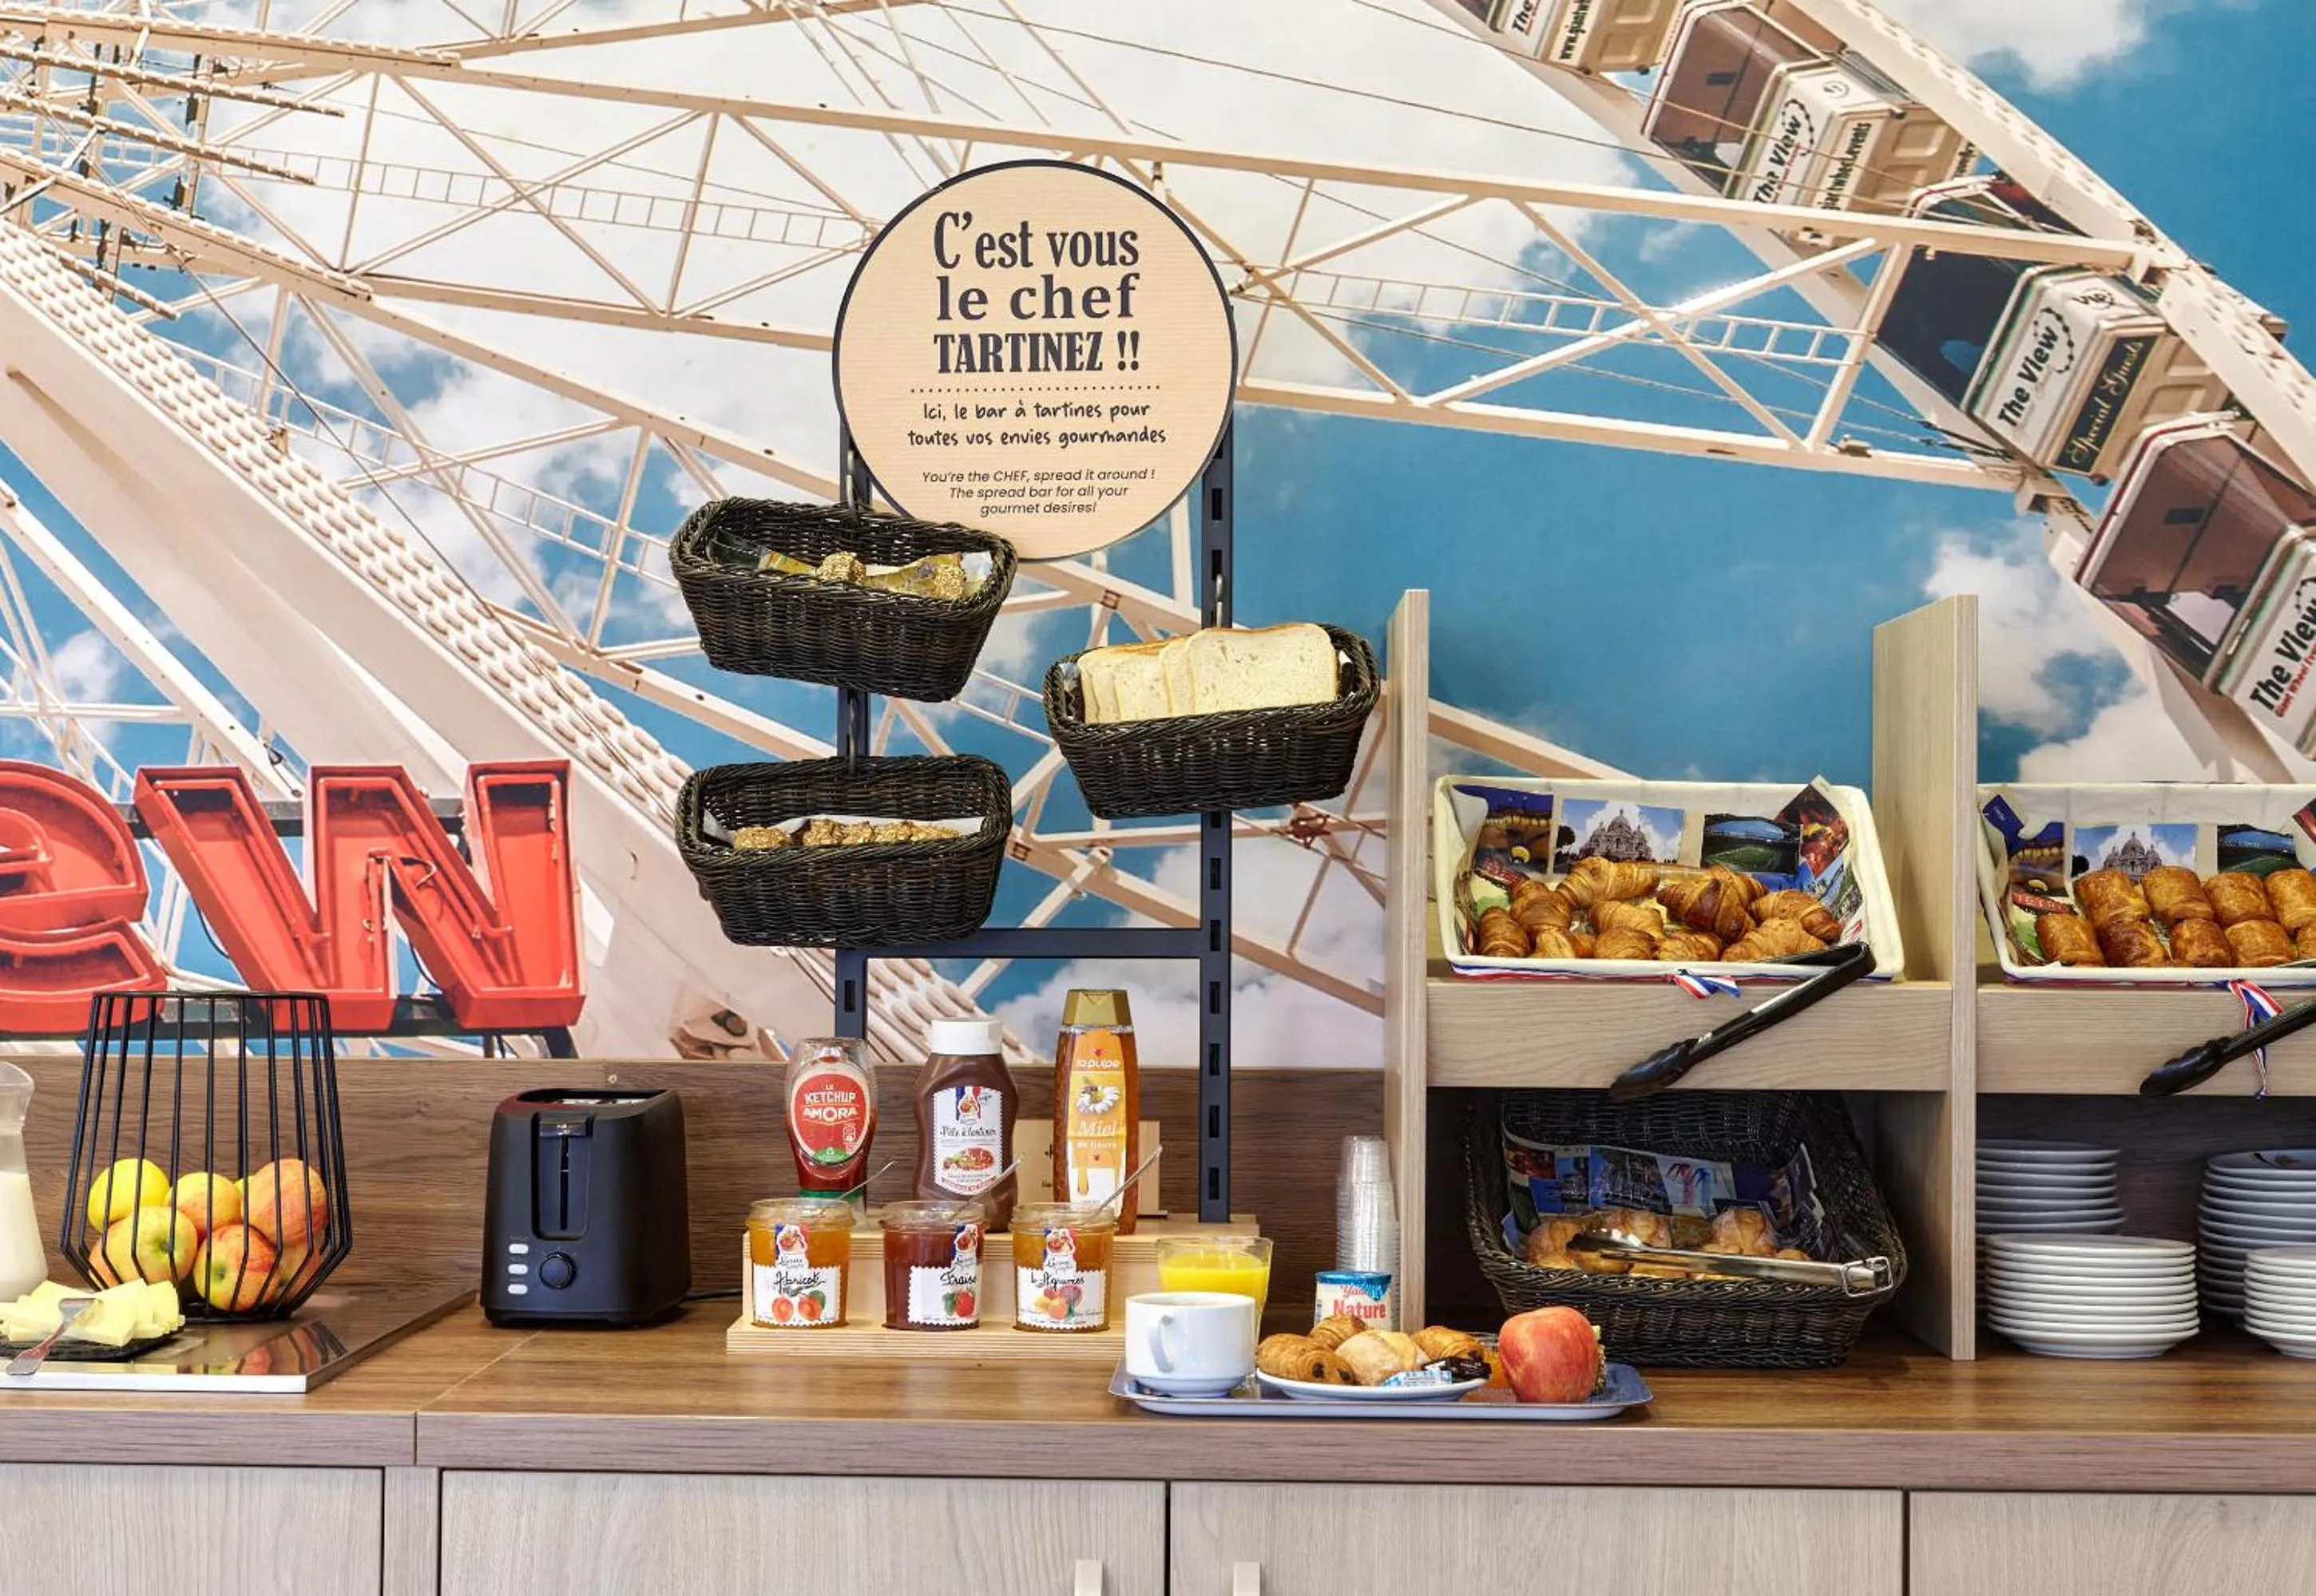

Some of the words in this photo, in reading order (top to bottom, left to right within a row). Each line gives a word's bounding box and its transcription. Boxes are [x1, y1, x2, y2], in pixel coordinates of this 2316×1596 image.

[934, 211, 1033, 269] C'est
[1046, 230, 1139, 267] vous
[936, 275, 989, 320] le
[1009, 272, 1140, 319] chef
[934, 331, 1104, 374] TARTINEZ
[1116, 330, 1140, 371] !!
[1997, 386, 2031, 427] The
[2017, 326, 2059, 385] View
[923, 402, 946, 422] Ici,
[954, 402, 968, 420] le
[975, 403, 1008, 420] bar
[1014, 398, 1026, 418] à
[1033, 402, 1102, 419] tartines
[1108, 403, 1152, 422] pour
[906, 429, 959, 446] toutes
[966, 431, 993, 446] vos
[1000, 428, 1052, 446] envies
[1058, 425, 1168, 449] gourmandes
[2066, 396, 2112, 464] Special
[922, 470, 965, 483] You're
[967, 470, 991, 483] the
[993, 469, 1030, 484] CHEF,
[1033, 469, 1083, 485] spread
[1085, 469, 1095, 481] it
[1097, 468, 1148, 481] around
[950, 486, 974, 499] The
[977, 485, 1026, 501] spread
[1029, 485, 1053, 498] bar
[1056, 485, 1075, 497] for
[1077, 485, 1095, 497] all
[1097, 485, 1129, 501] your
[979, 502, 1040, 518] gourmet
[1043, 501, 1098, 514] desires!
[2249, 665, 2293, 711] The
[804, 1091, 856, 1104] KETCHUP
[803, 1107, 858, 1123] AMORA
[1077, 1119, 1117, 1137] Miel
[1334, 1299, 1386, 1320] Nature
